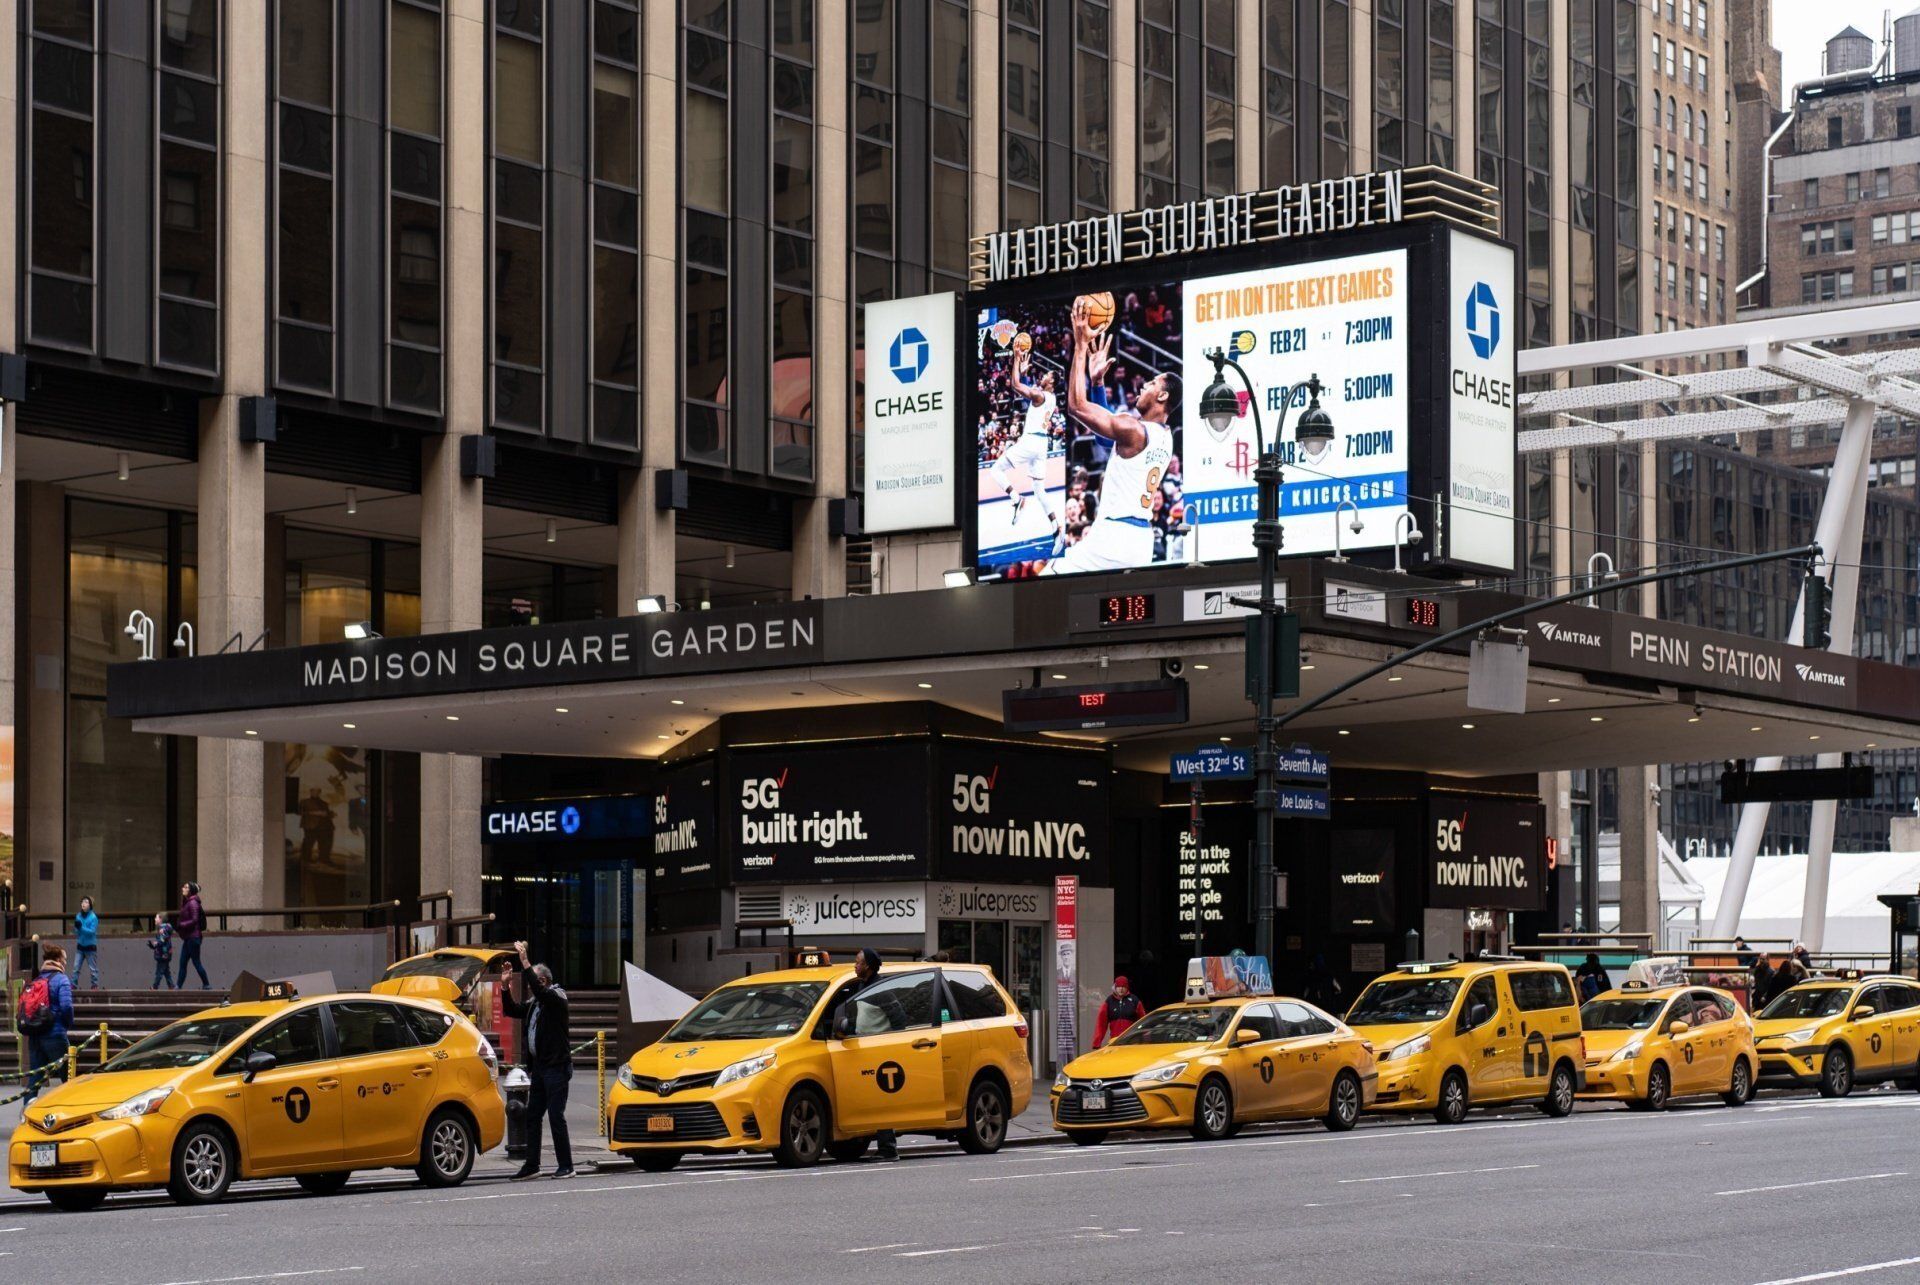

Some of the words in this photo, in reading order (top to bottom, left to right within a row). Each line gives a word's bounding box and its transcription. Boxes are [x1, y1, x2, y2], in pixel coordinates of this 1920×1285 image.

[989, 213, 1122, 281] MADISON
[1141, 191, 1257, 258] SQUARE
[1277, 170, 1402, 238] GARDEN
[1195, 291, 1224, 323] GET
[1226, 289, 1240, 319] IN
[1243, 286, 1263, 317] ON
[1266, 281, 1295, 313] THE
[1297, 276, 1336, 309] NEXT
[1338, 267, 1393, 304] GAMES
[1270, 330, 1291, 355] FEB
[1293, 327, 1307, 352] 21
[1345, 316, 1393, 345] 7:30PM
[1344, 373, 1393, 402] 5:00PM
[1452, 369, 1511, 408] CHASE
[875, 391, 943, 418] CHASE
[881, 424, 909, 436] MARQUEE
[912, 421, 938, 433] PARTNER
[1345, 430, 1393, 458] 7:00PM
[876, 478, 899, 491] MADISON
[901, 476, 921, 489] SQUARE
[922, 474, 943, 487] GARDEN
[1452, 482, 1474, 500] MADISON
[1475, 486, 1492, 506] SQUARE
[1493, 491, 1511, 510] GARDEN
[1195, 494, 1259, 517] TICKETS
[1292, 480, 1394, 507] KNICKS.COM
[304, 648, 457, 687] MADISON
[479, 633, 631, 672] SQUARE
[651, 617, 815, 658] GARDEN
[1554, 629, 1600, 647] AMTRAK
[1630, 630, 1690, 668] PENN
[1701, 643, 1782, 683] STATION
[1808, 671, 1846, 687] AMTRAK
[1080, 693, 1106, 706] TEST
[1176, 758, 1204, 775] West
[1207, 755, 1230, 773] 32nd
[1233, 756, 1245, 771] St
[1279, 756, 1310, 773] Seventh
[1312, 759, 1327, 774] Ave
[742, 778, 780, 810] 5G
[952, 774, 990, 814] 5G
[1281, 794, 1293, 808] Joe
[1295, 795, 1313, 810] Louis
[1315, 801, 1326, 809] Plaza
[488, 810, 557, 834] CHASE
[655, 796, 668, 825] 5G
[655, 831, 672, 854] now
[672, 823, 679, 850] in
[679, 819, 697, 850] NYC.
[742, 813, 798, 845] built
[803, 810, 868, 848] right.
[953, 824, 1004, 855] now
[1008, 819, 1030, 857] in
[1034, 821, 1090, 860] NYC.
[1436, 819, 1461, 851] 5G
[743, 854, 773, 866] verizon
[843, 855, 864, 863] network
[879, 854, 896, 862] people
[897, 853, 906, 862] rely
[1210, 845, 1231, 859] the
[1179, 860, 1230, 875] nework
[1341, 872, 1379, 884] verizon
[1437, 861, 1472, 886] now
[1473, 855, 1488, 886] in
[1490, 856, 1528, 888] NYC.
[958, 887, 1037, 916] juicepress
[1057, 886, 1074, 894] NYC
[1179, 889, 1222, 907] peple
[814, 894, 917, 924] juicepress
[1204, 908, 1224, 920] on.
[1483, 1047, 1496, 1058] NYC
